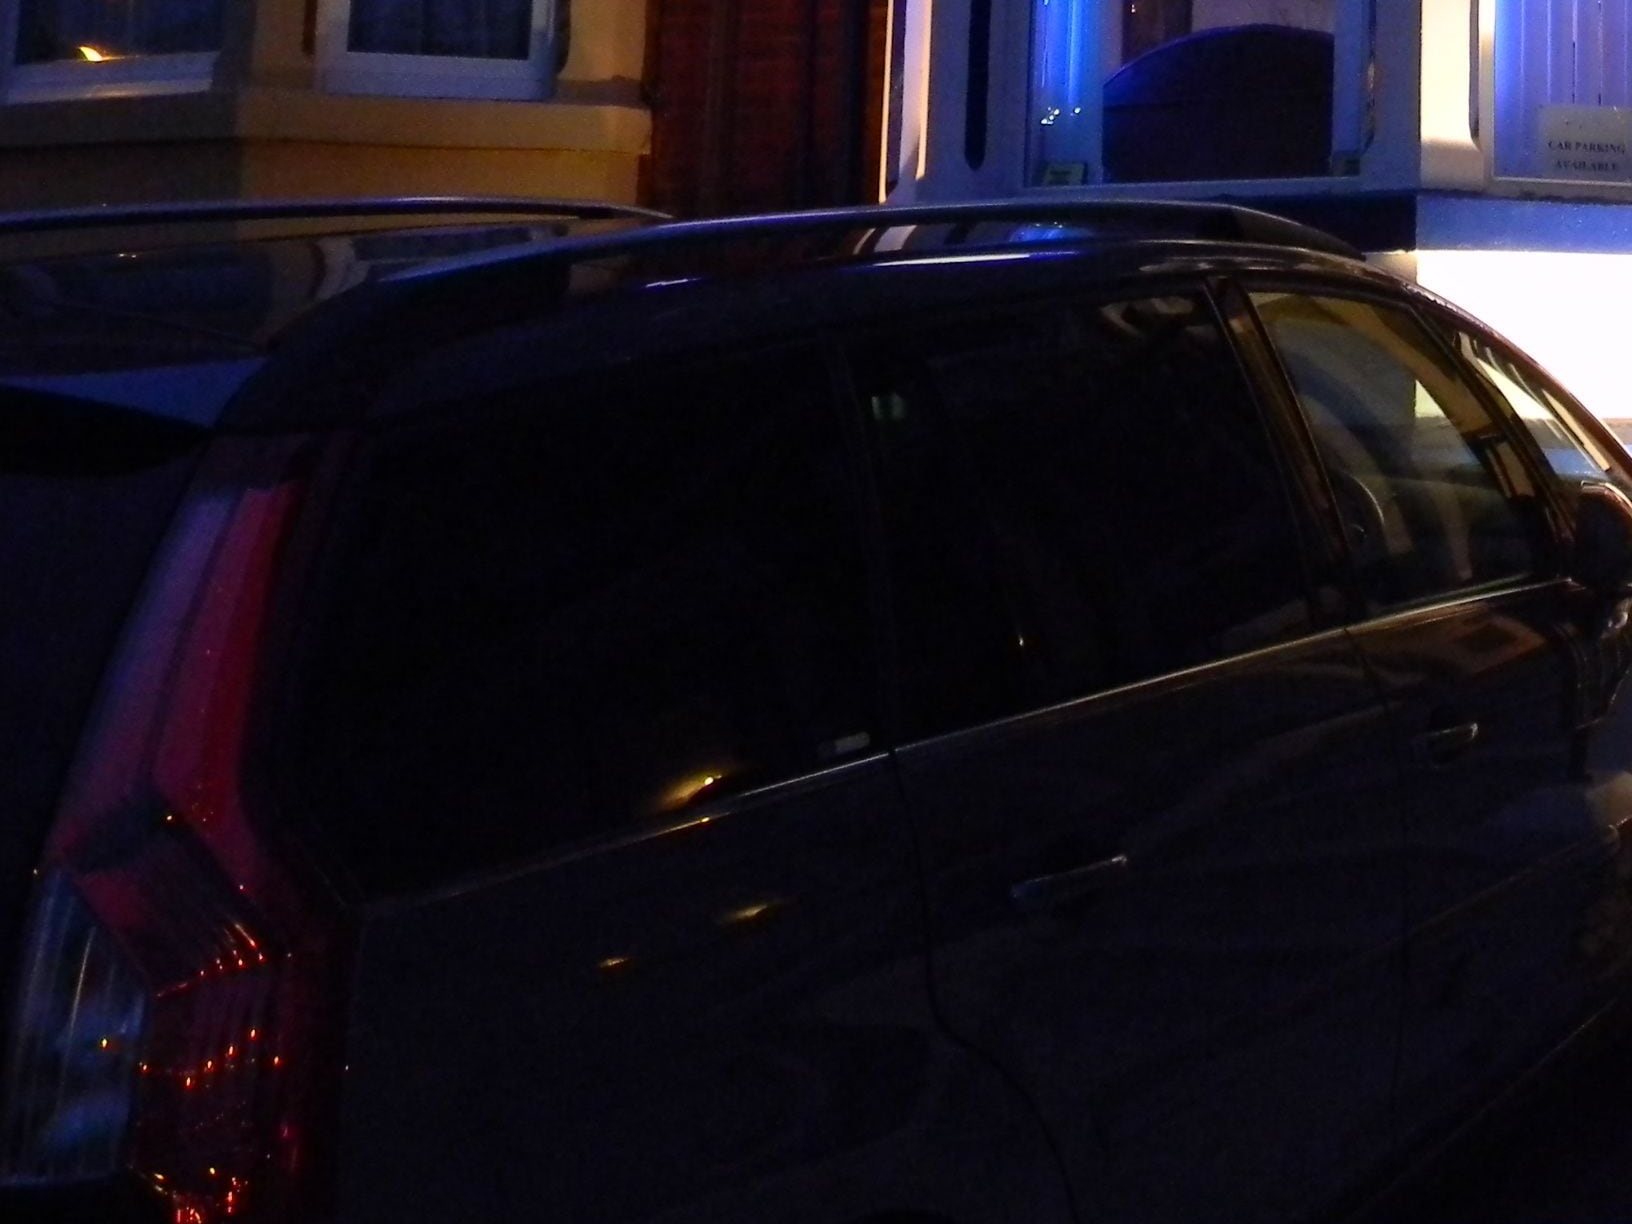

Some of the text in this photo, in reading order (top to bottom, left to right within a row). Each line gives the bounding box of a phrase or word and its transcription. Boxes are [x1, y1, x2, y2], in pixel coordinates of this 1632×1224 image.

[1548, 140, 1626, 155] CAR PARKING
[1555, 160, 1617, 172] AVAILABLE
